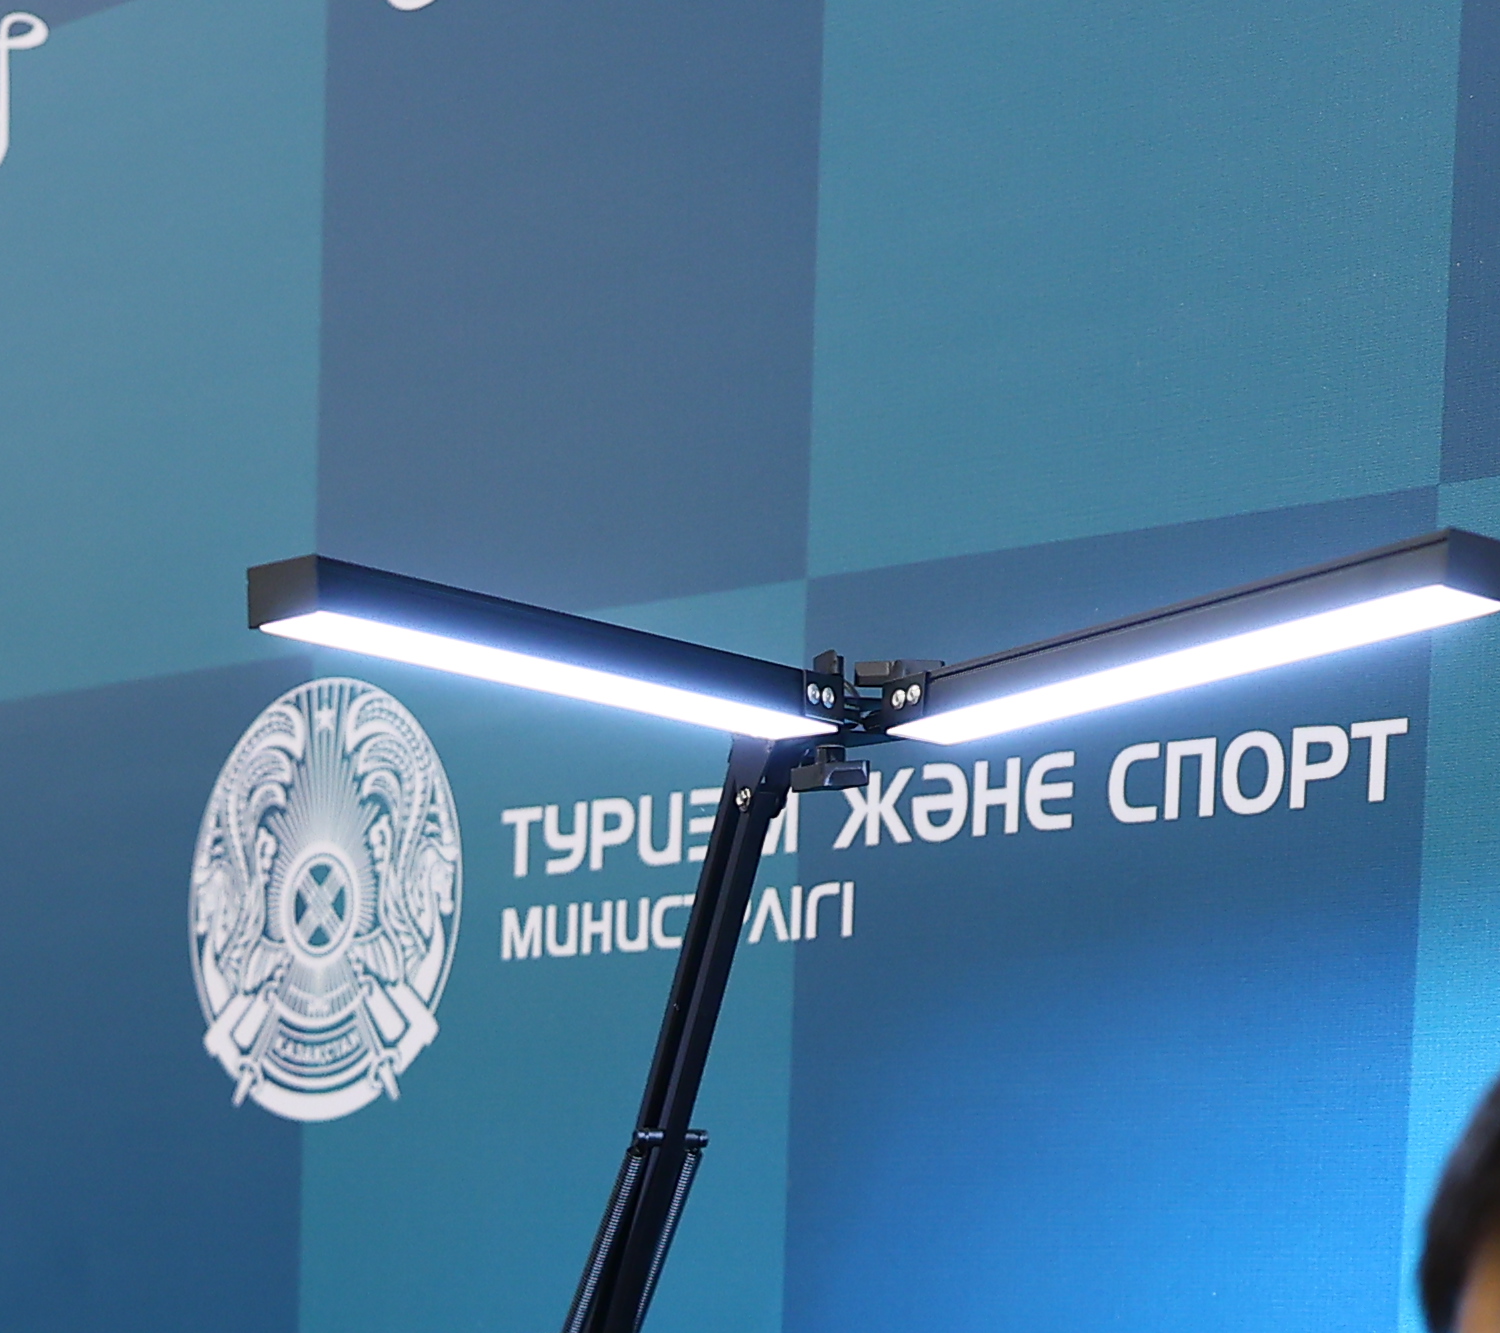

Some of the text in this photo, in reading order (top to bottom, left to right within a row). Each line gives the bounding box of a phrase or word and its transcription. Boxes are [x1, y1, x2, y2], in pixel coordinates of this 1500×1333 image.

[833, 750, 1076, 851] ЖӘНЕ
[1106, 716, 1409, 825] СПОРТ
[500, 880, 856, 962] МИНИСЛІГІ
